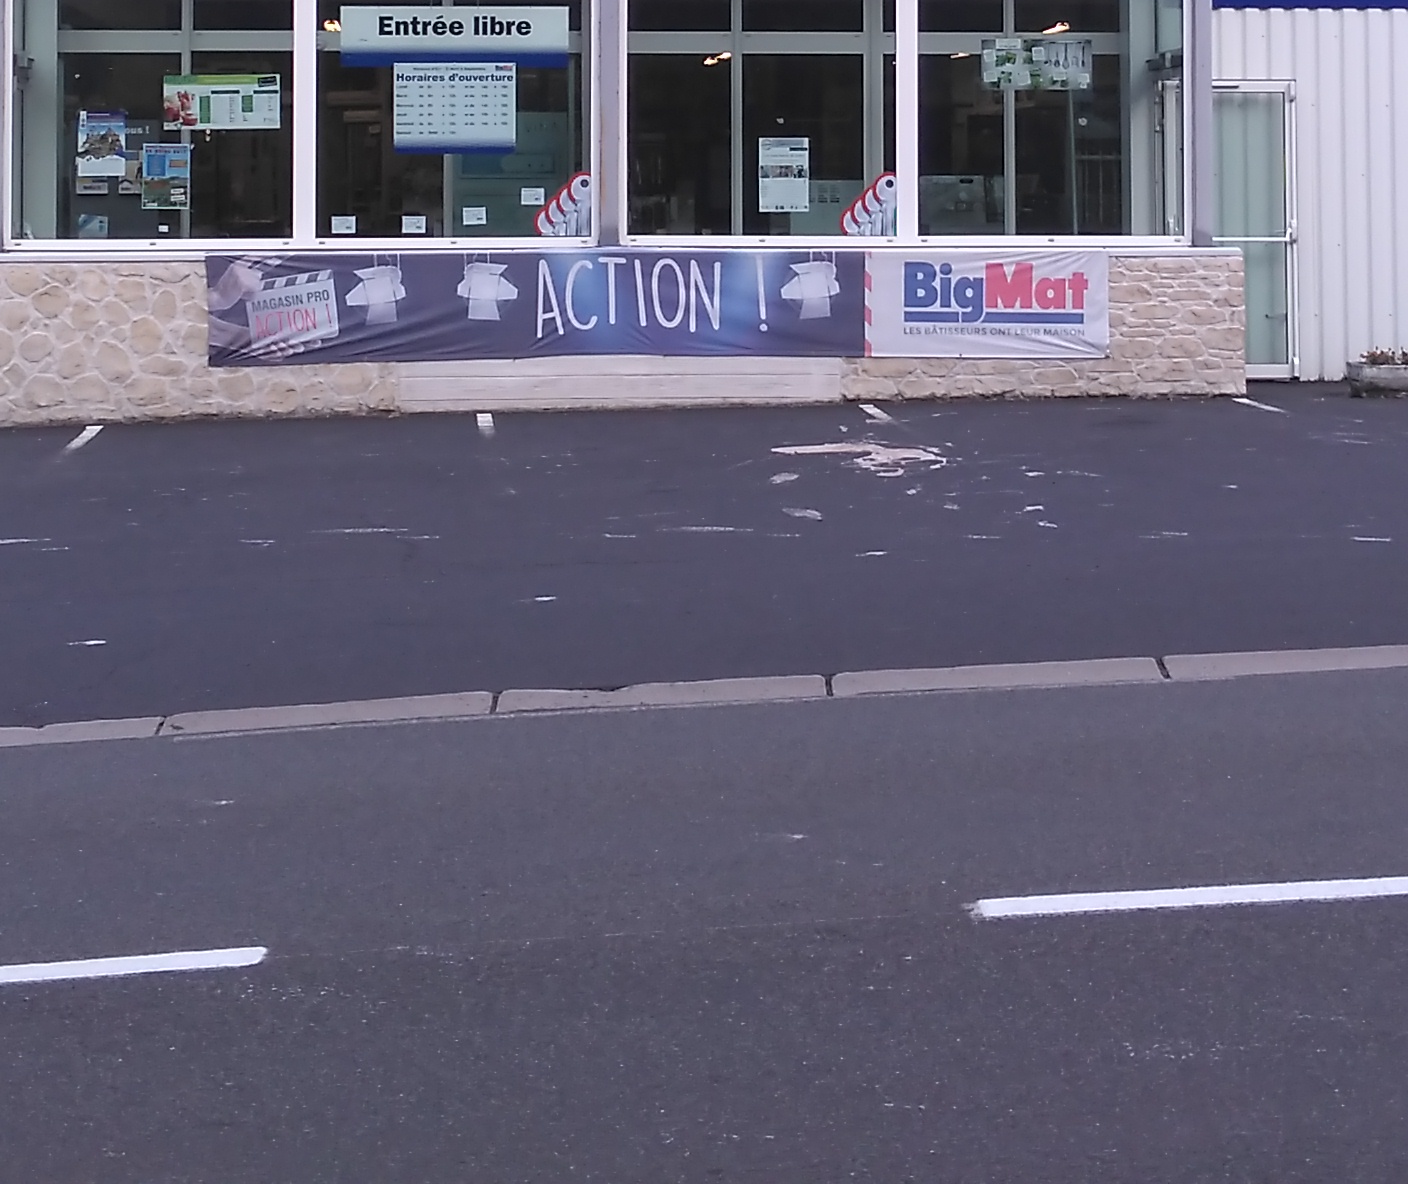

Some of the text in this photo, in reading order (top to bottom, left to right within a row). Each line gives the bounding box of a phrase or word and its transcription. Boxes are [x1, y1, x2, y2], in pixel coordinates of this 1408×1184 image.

[378, 14, 532, 36] Entrée libre
[396, 73, 514, 82] Horaires d'ouverture
[252, 289, 330, 313] MAGASIN PRO
[536, 255, 768, 338] ACTION !
[903, 261, 1089, 323] BigMat
[255, 303, 333, 340] ACTION !
[903, 325, 1085, 337] LES BÂTISSEURS ONT LEUR MAISON
